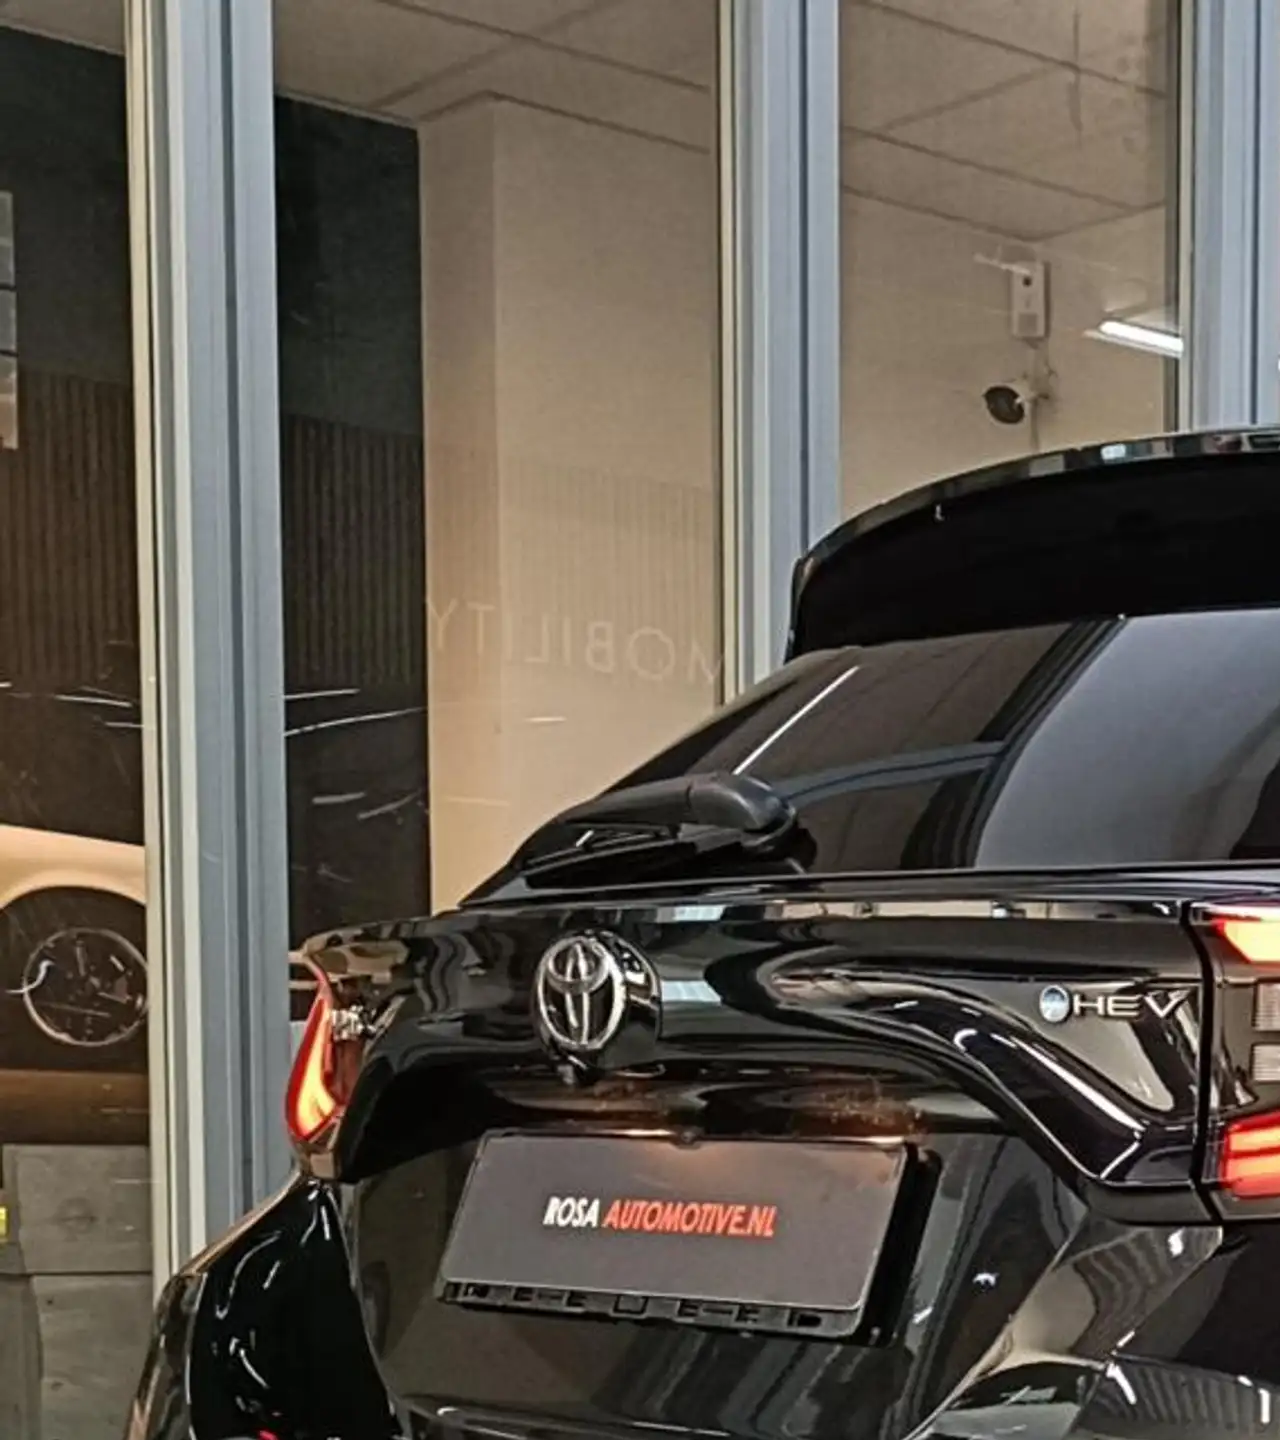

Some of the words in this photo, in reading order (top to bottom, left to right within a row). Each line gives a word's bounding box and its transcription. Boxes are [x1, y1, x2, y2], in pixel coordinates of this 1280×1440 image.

[1072, 989, 1191, 1018] HEV
[543, 1196, 600, 1228] ROSA
[601, 1199, 777, 1238] AUTOMOTIVE.NL
